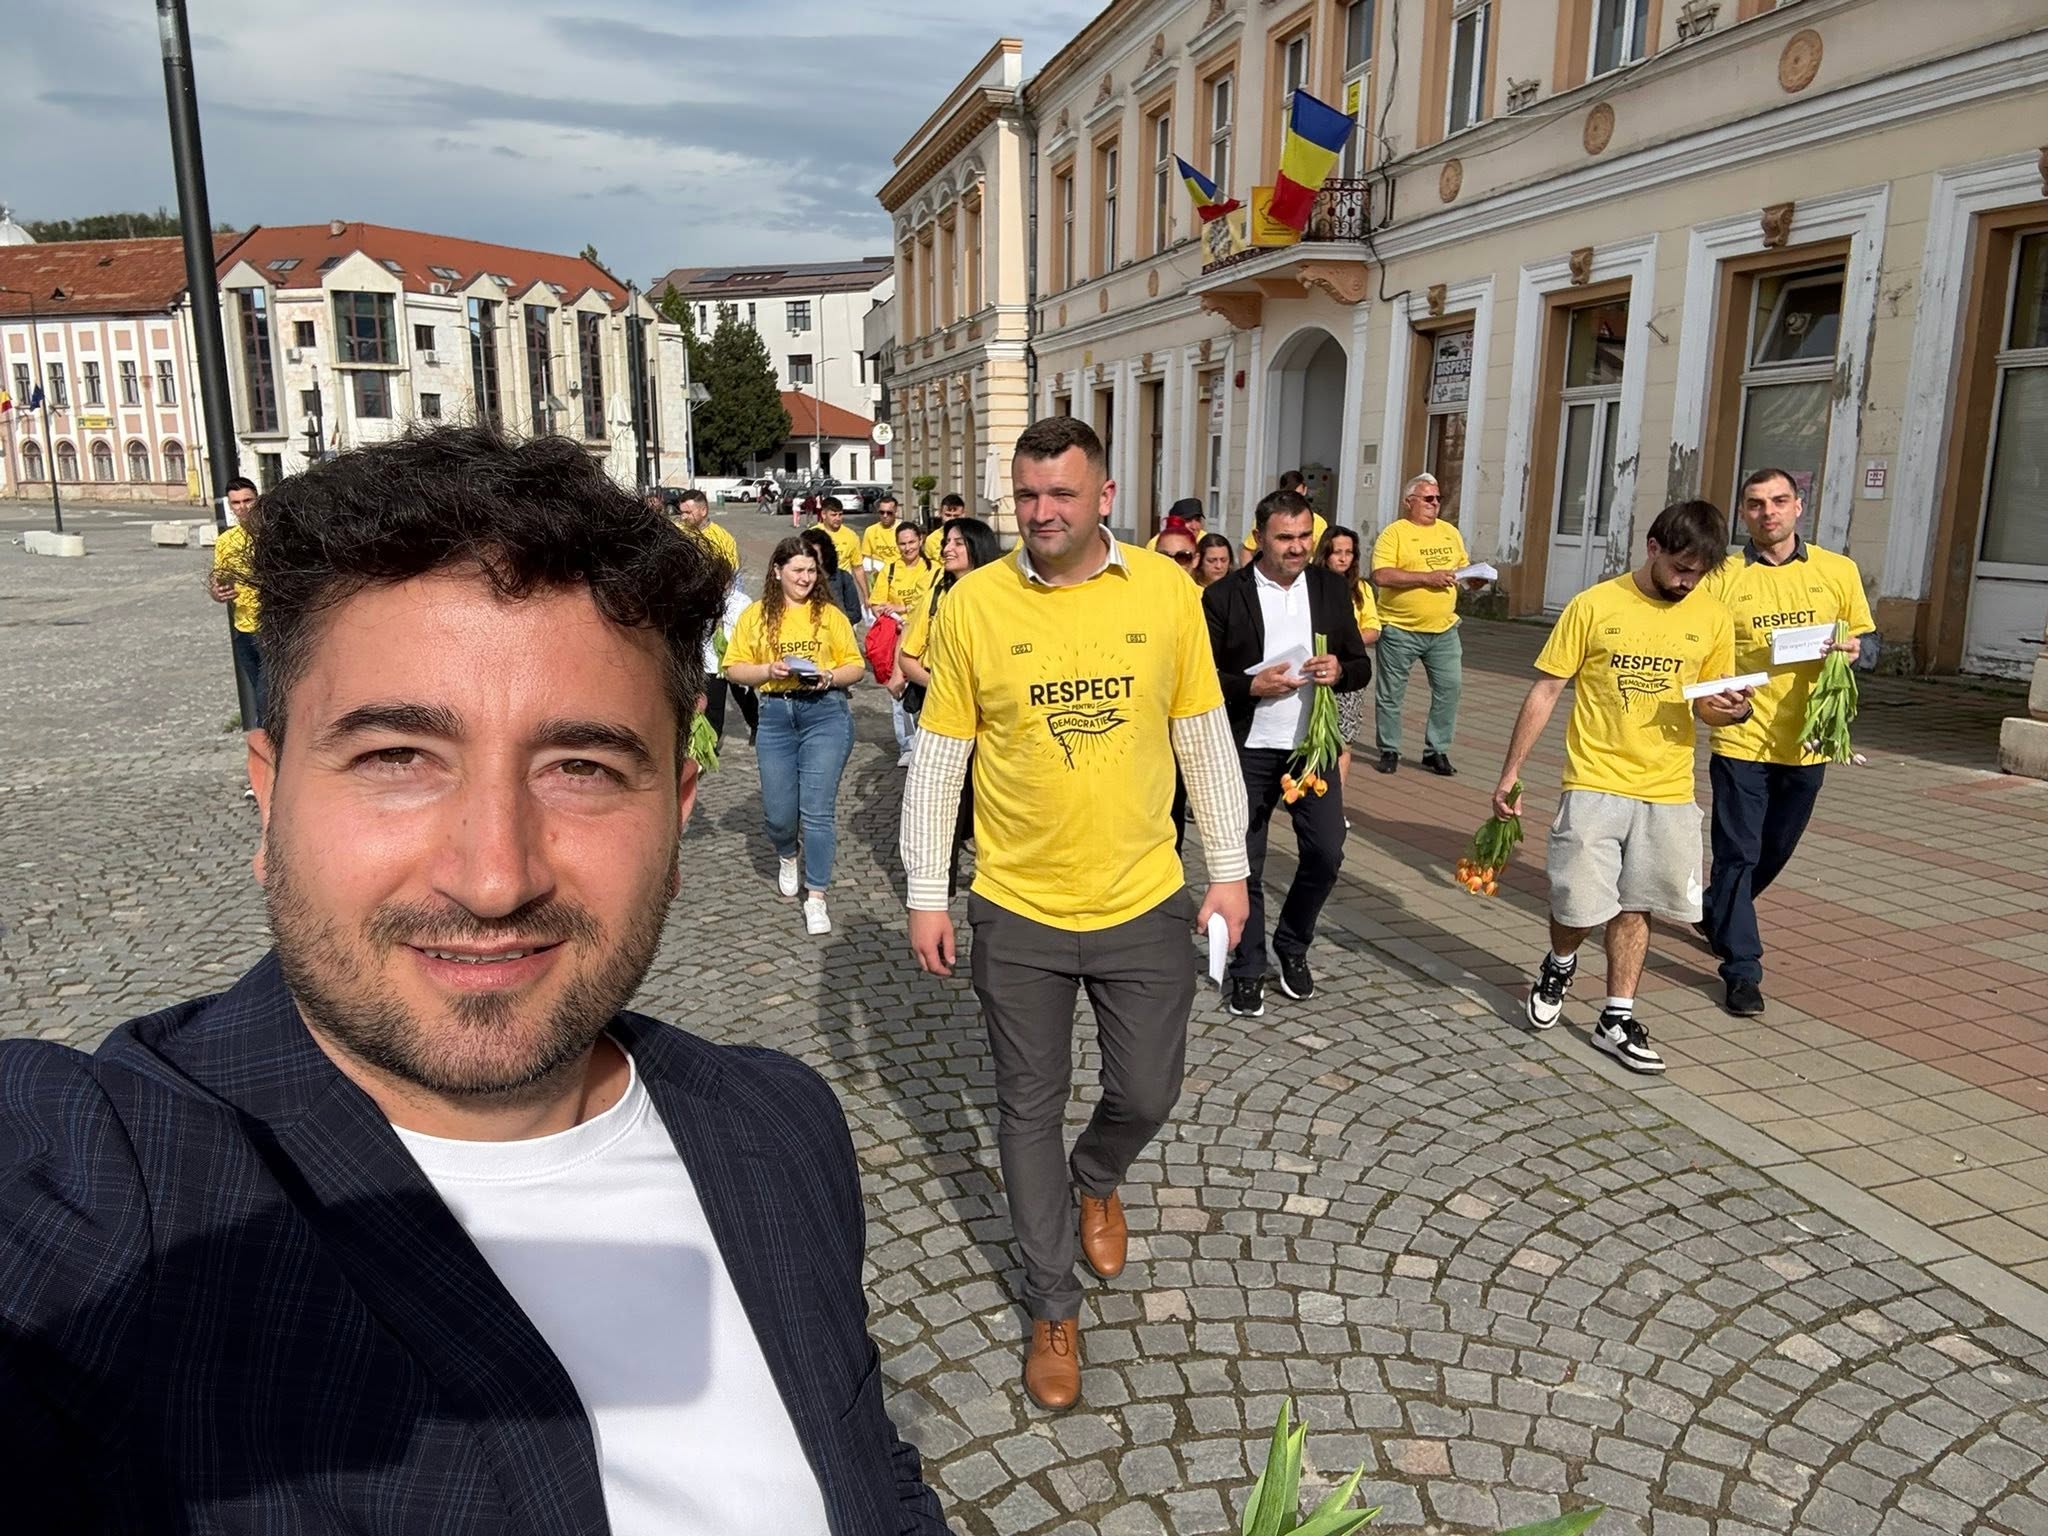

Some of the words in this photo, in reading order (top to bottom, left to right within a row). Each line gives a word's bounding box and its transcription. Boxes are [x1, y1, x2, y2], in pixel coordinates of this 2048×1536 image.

[1420, 547, 1453, 556] RESPECT
[1752, 610, 1816, 629] RESPECT
[780, 640, 822, 653] ESPECT
[1610, 654, 1684, 674] RESPECT
[1030, 676, 1135, 707] RESPECT
